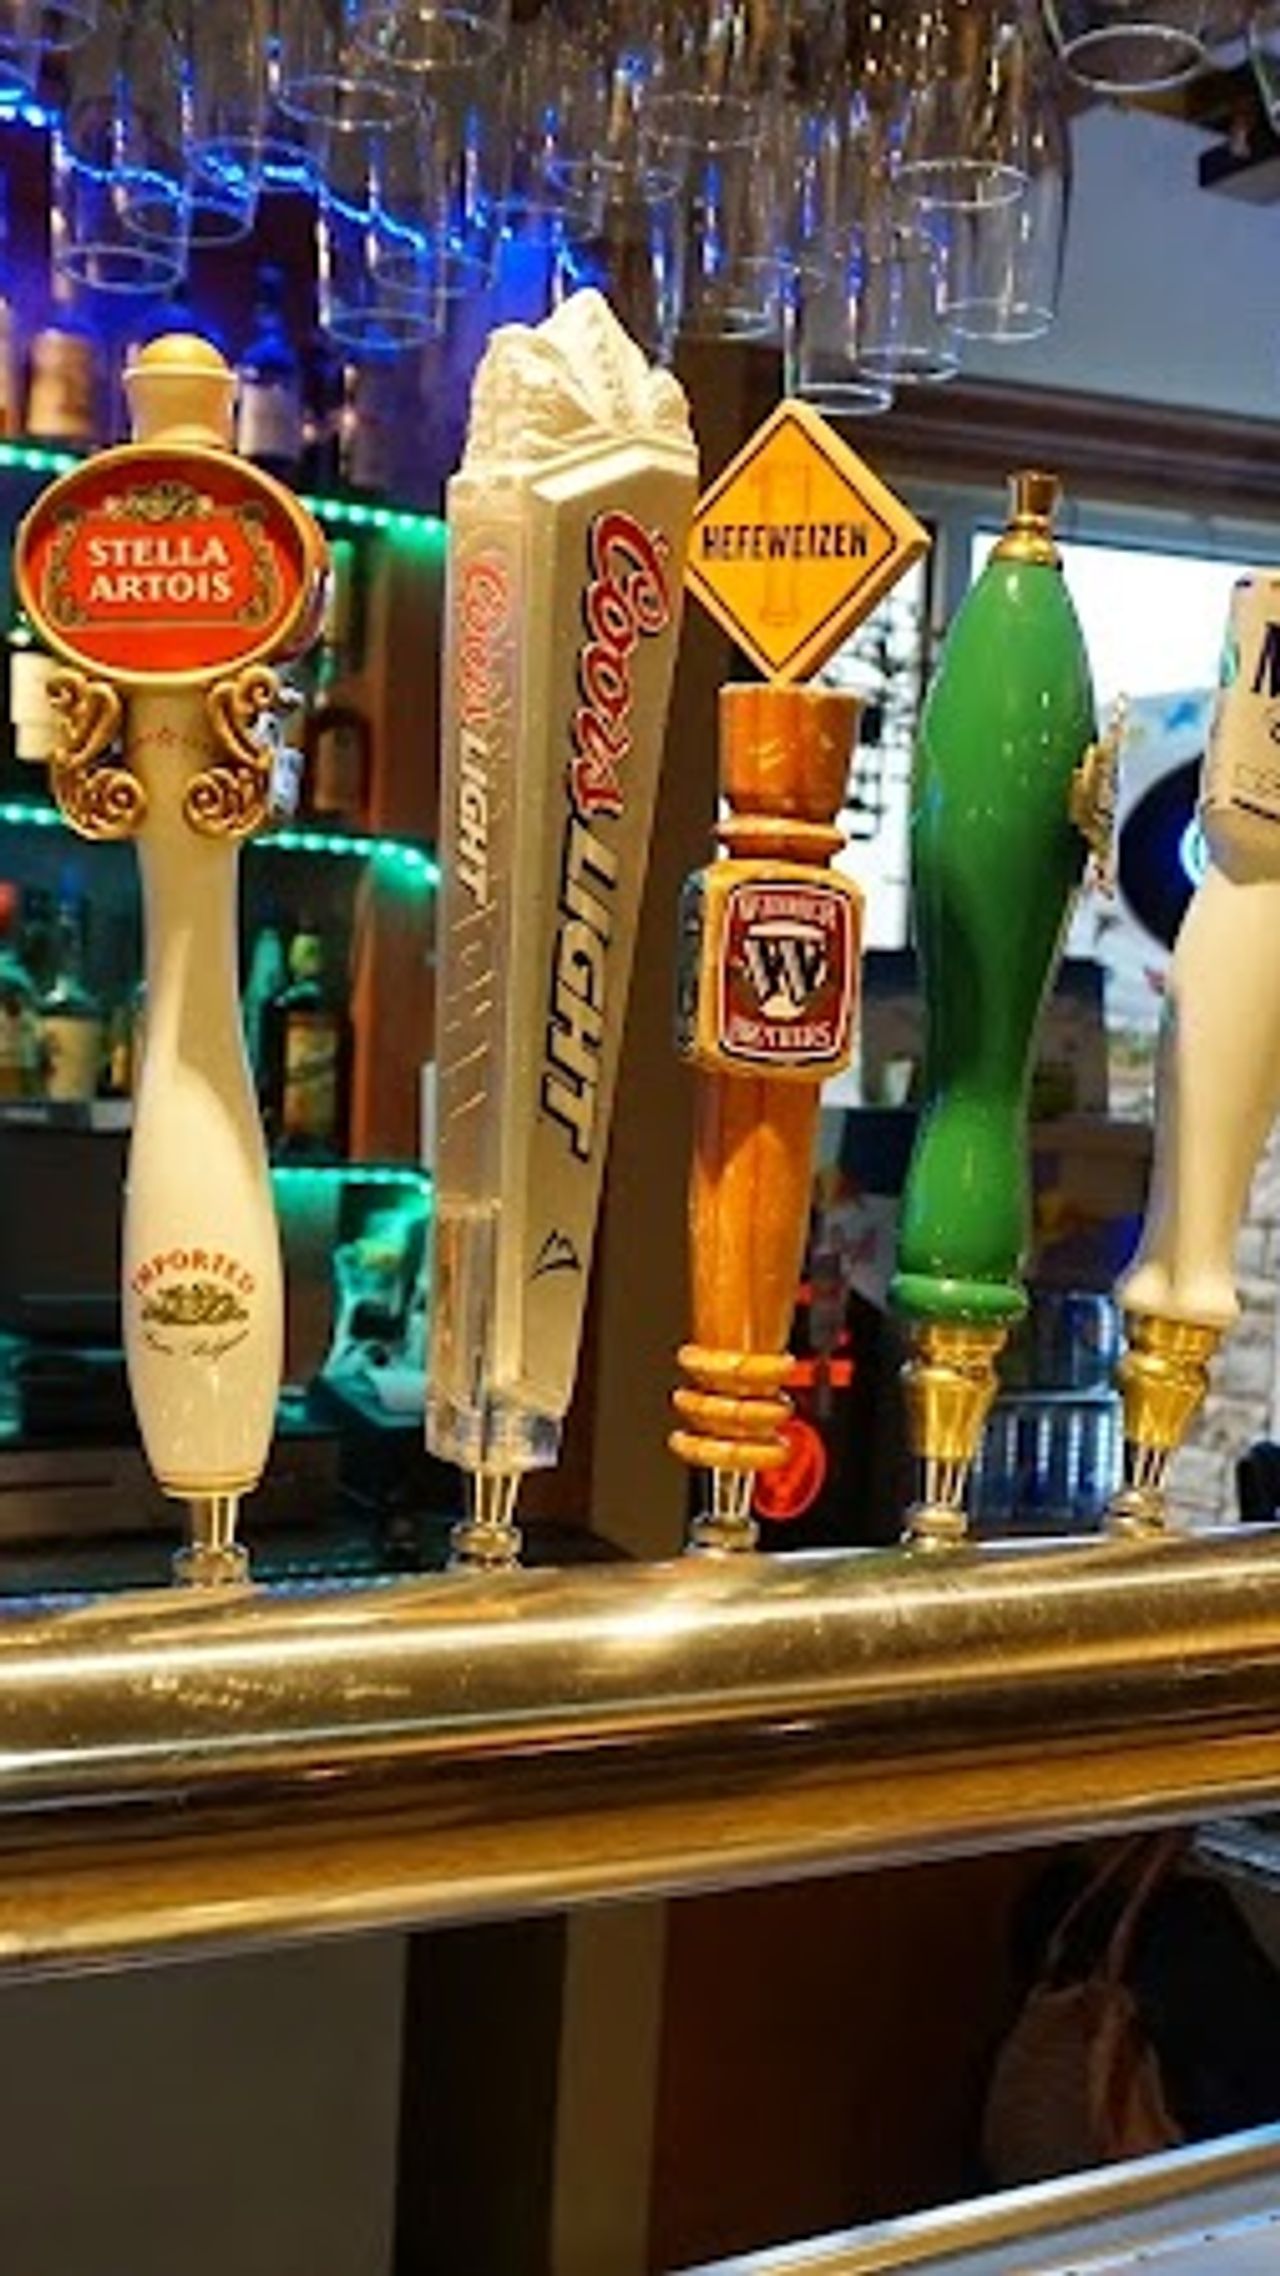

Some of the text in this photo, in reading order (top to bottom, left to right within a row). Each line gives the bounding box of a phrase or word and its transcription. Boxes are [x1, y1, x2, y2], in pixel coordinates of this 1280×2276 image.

[87, 536, 230, 568] STELLA
[702, 524, 867, 560] HEFEWEIZEN
[89, 570, 235, 602] ARTOIS
[458, 727, 489, 904] LIGHT
[541, 510, 670, 1164] Coors LIGHT
[131, 1249, 255, 1296] IMPORTED
